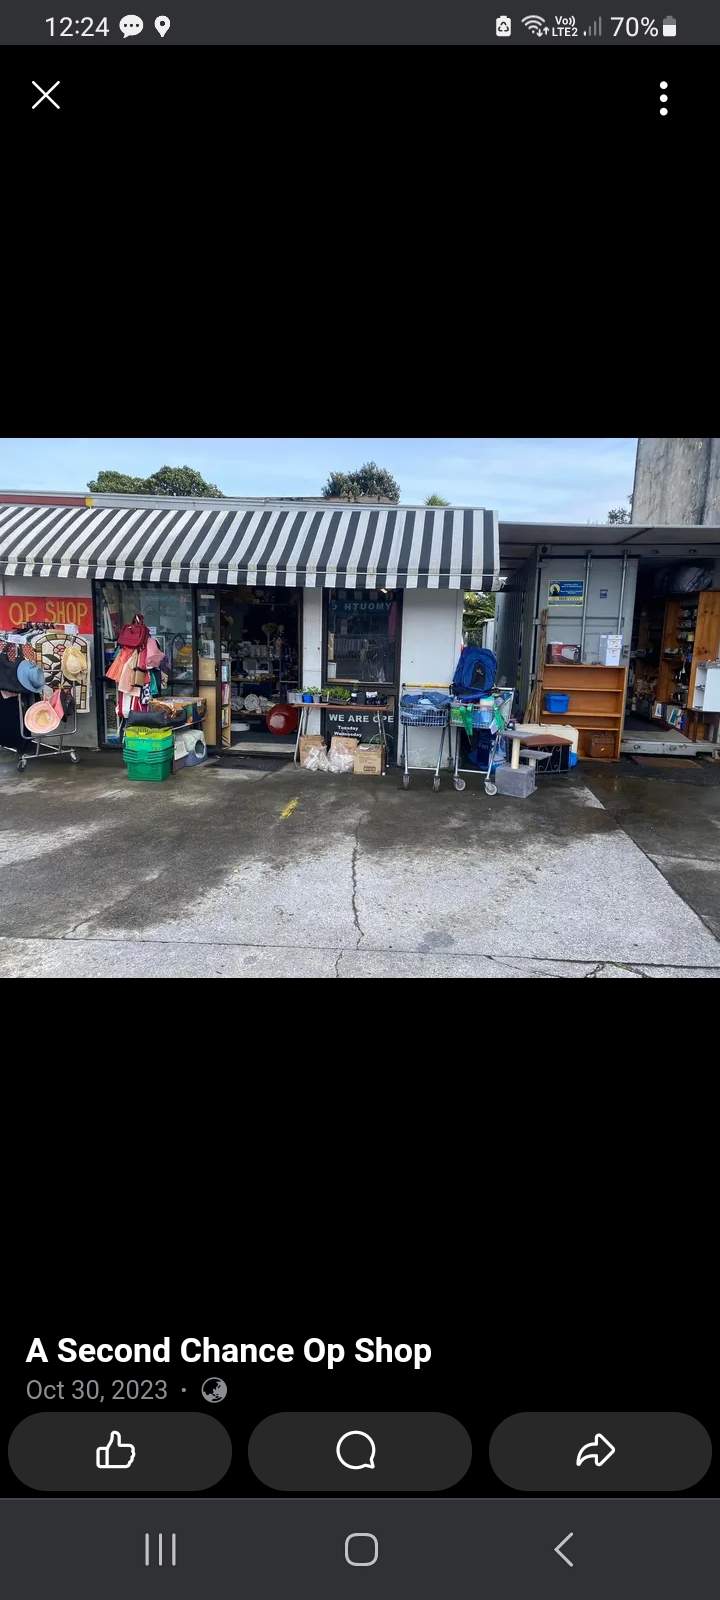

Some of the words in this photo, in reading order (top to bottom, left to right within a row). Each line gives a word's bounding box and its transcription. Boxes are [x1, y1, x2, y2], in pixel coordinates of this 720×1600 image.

[9, 601, 37, 625] OP
[46, 600, 88, 625] SHOP
[328, 713, 345, 722] WE
[347, 715, 370, 723] ARE
